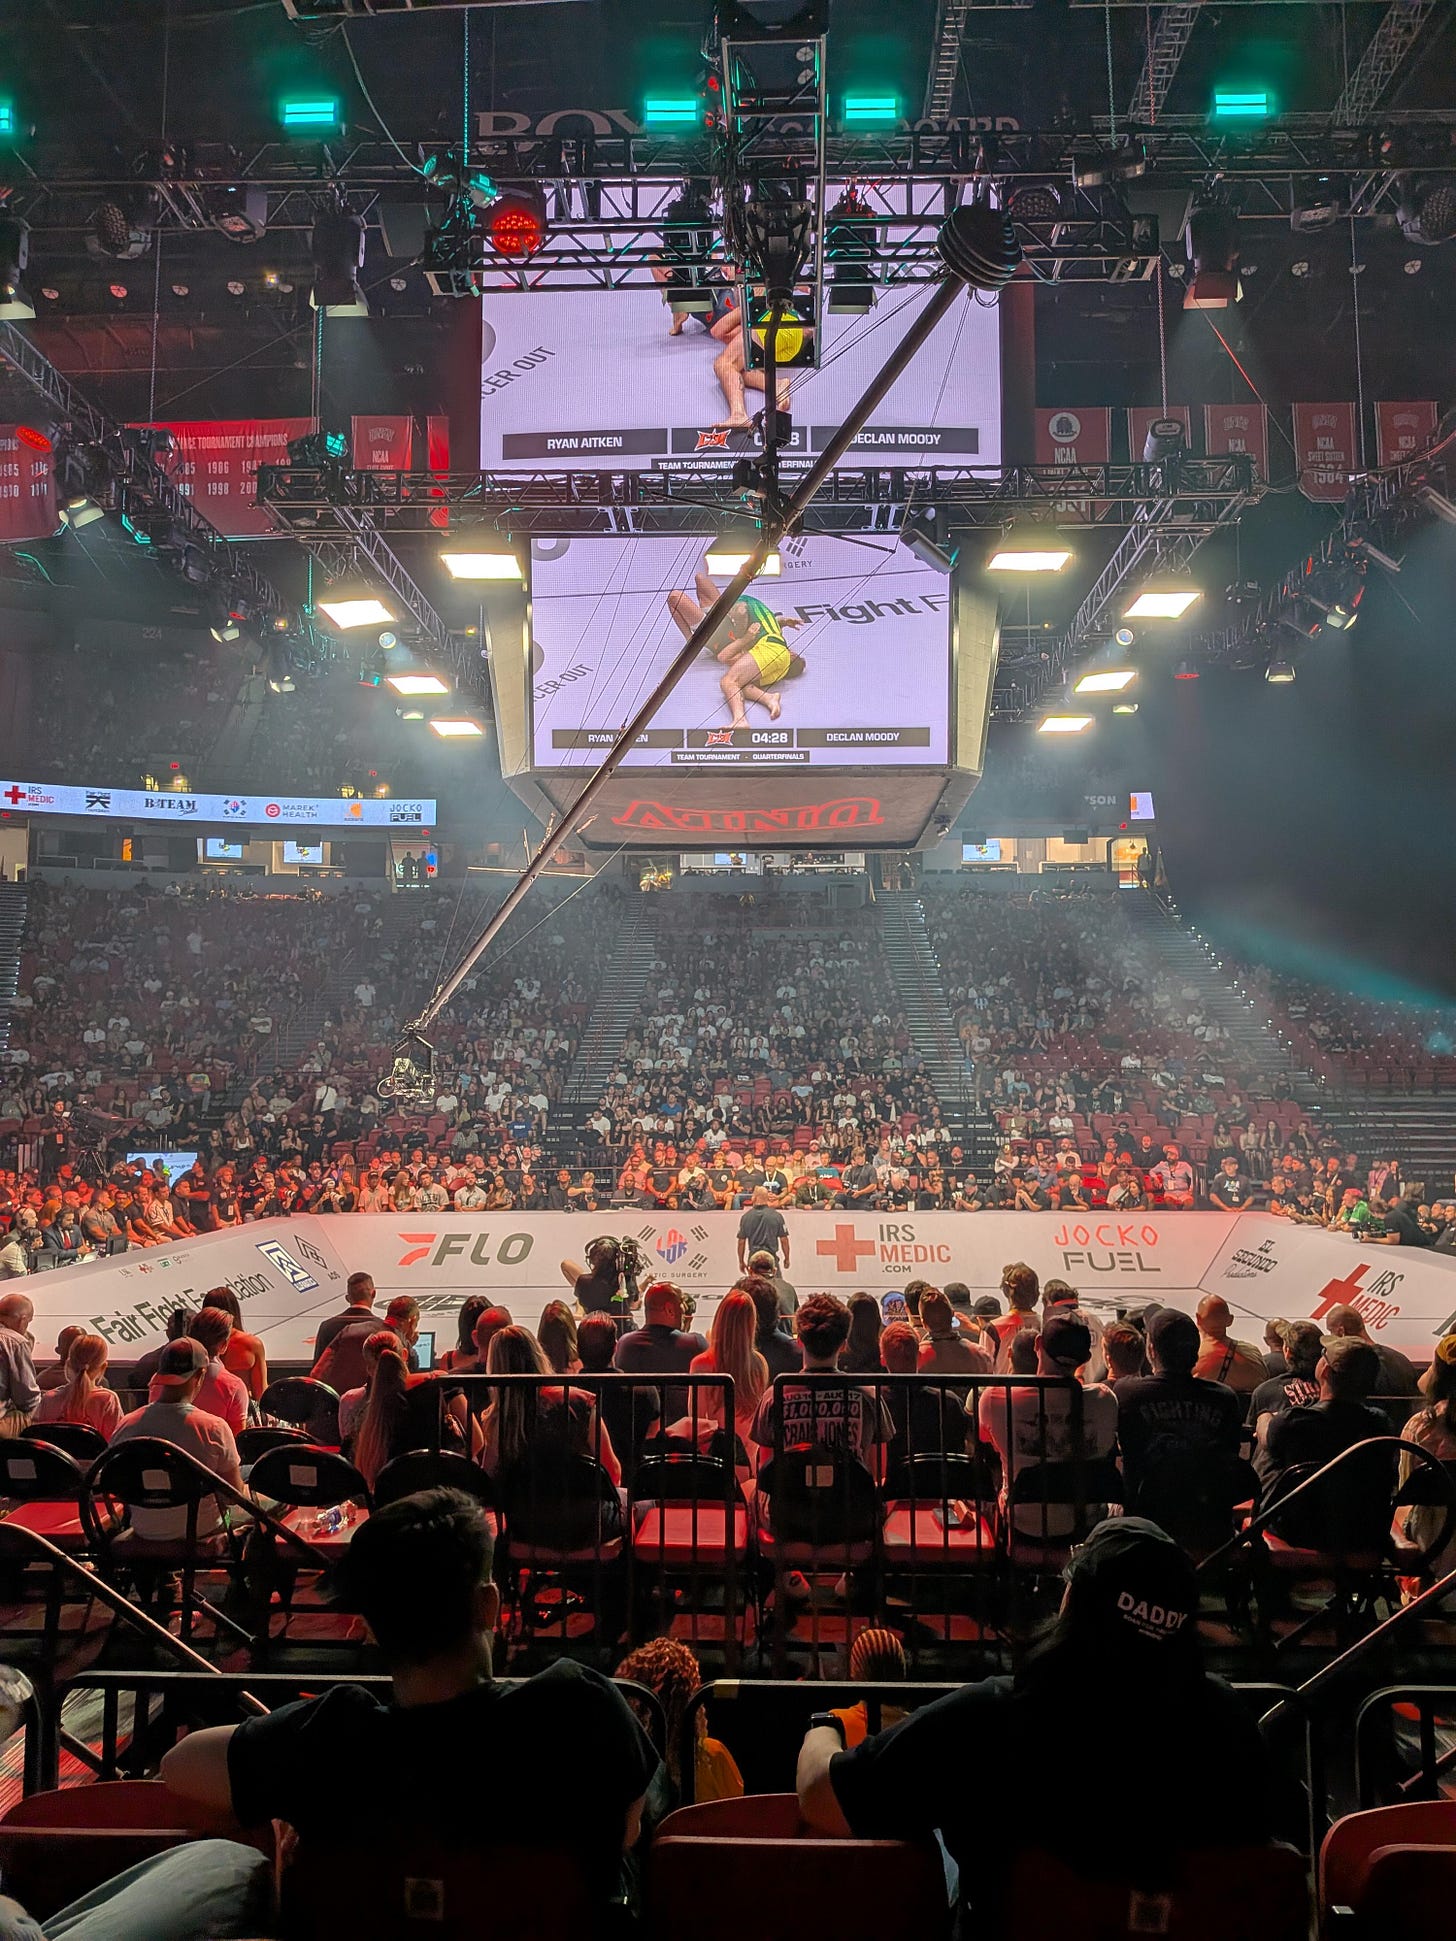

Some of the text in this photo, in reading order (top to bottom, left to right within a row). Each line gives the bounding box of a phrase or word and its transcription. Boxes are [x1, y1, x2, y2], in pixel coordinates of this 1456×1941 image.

[513, 346, 555, 370] OUT
[198, 436, 245, 449] TOURNAMENT
[547, 436, 623, 450] RYAN AITKEN
[897, 434, 941, 445] MOODY
[1316, 436, 1334, 450] NCAA
[1054, 447, 1077, 464] NCAA
[658, 462, 681, 470] TEAM
[794, 598, 922, 625] Fight
[559, 664, 593, 681] OUT
[588, 734, 614, 743] RYAN
[751, 732, 788, 744] 04:28
[826, 732, 900, 742] DECLAN MOODY
[695, 753, 741, 761] TOURNAMENT
[752, 752, 805, 761] QUARTERFINALS
[27, 786, 42, 795] IRS
[27, 794, 55, 804] MEDIC
[282, 811, 318, 819] HEALTH
[389, 803, 423, 813] JOCKO
[879, 1223, 916, 1243] IRS
[1054, 1224, 1159, 1247] JOCKO
[431, 1232, 535, 1266] FLO
[879, 1243, 952, 1263] MEDIC
[881, 1264, 912, 1273] .COM
[1062, 1251, 1162, 1272] FUEL
[1231, 1248, 1279, 1274] SEGUNDO
[1366, 1269, 1405, 1297] IRS
[1351, 1294, 1401, 1331] MEDIC
[89, 1310, 148, 1345] Fair
[1117, 1591, 1188, 1629] DADDY
